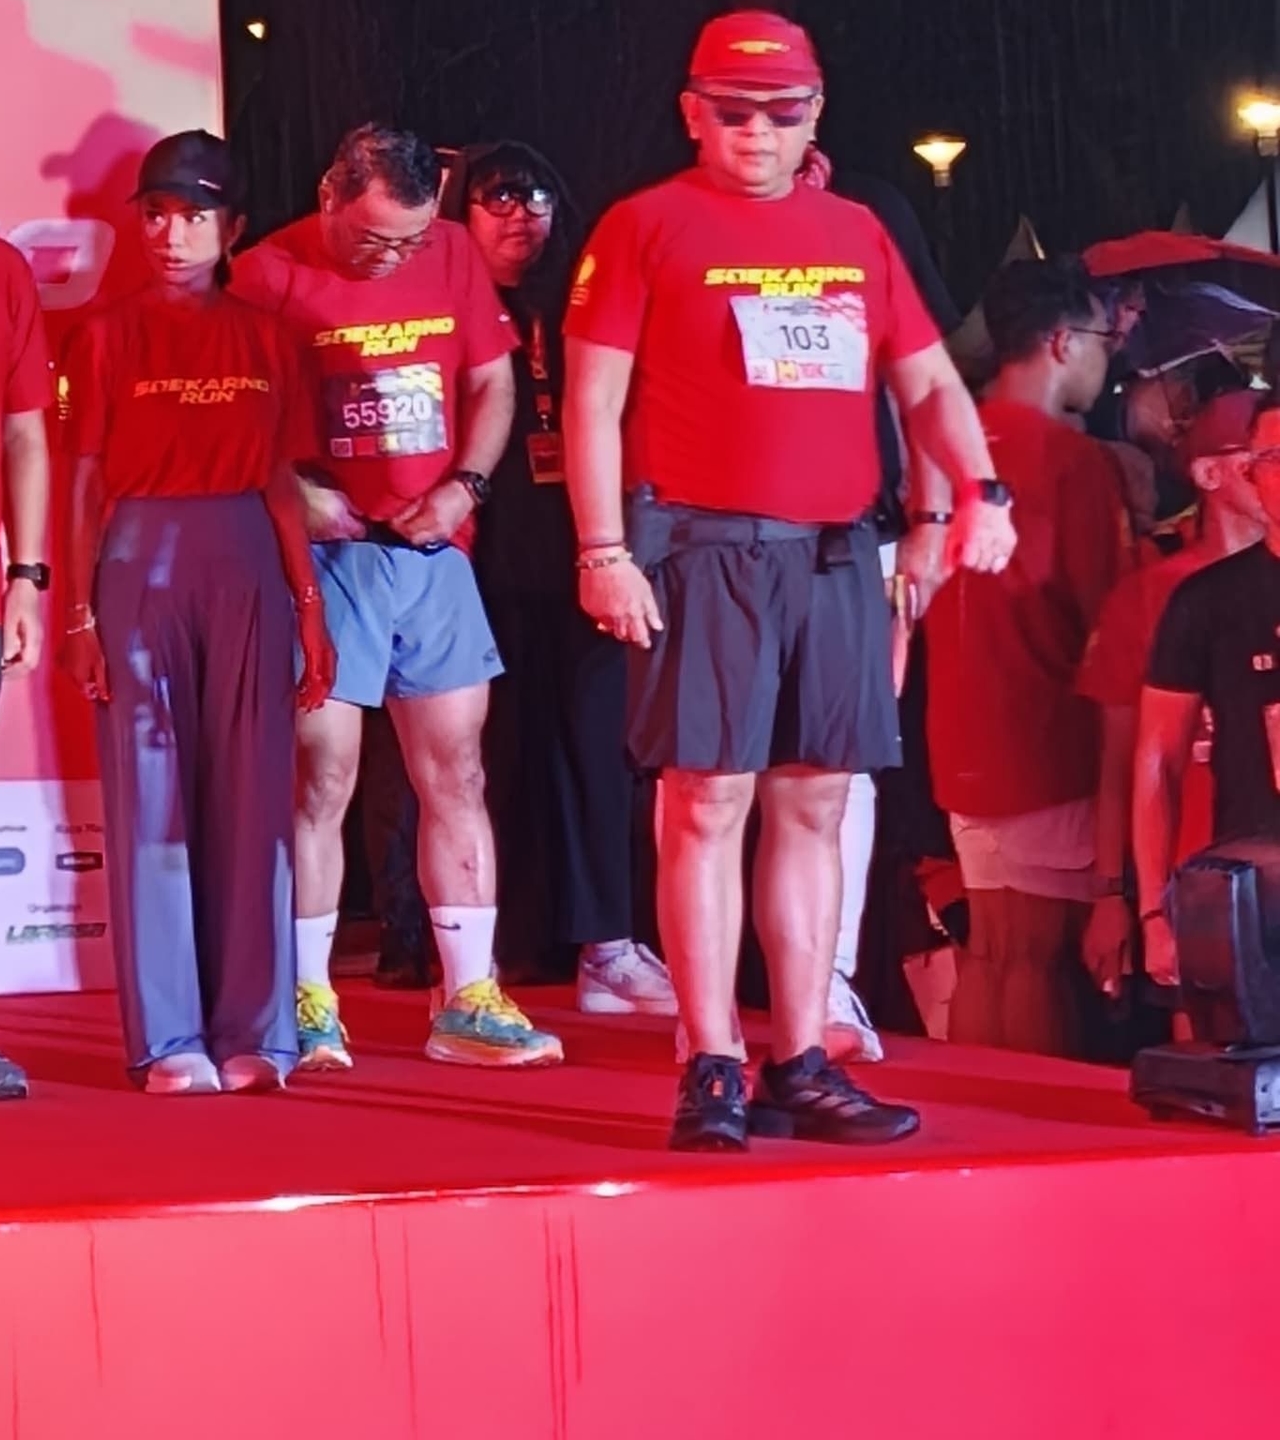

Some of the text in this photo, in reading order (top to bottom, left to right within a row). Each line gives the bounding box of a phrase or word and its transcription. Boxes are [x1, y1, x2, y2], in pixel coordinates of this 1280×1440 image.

[704, 266, 866, 285] SOEKARNO
[759, 281, 824, 297] RUN
[313, 316, 455, 347] SOEKARNO
[780, 324, 830, 351] 103
[360, 336, 420, 357] RUN
[132, 376, 270, 398] SOEKARNO
[179, 390, 235, 405] RUN
[343, 391, 433, 429] 55920
